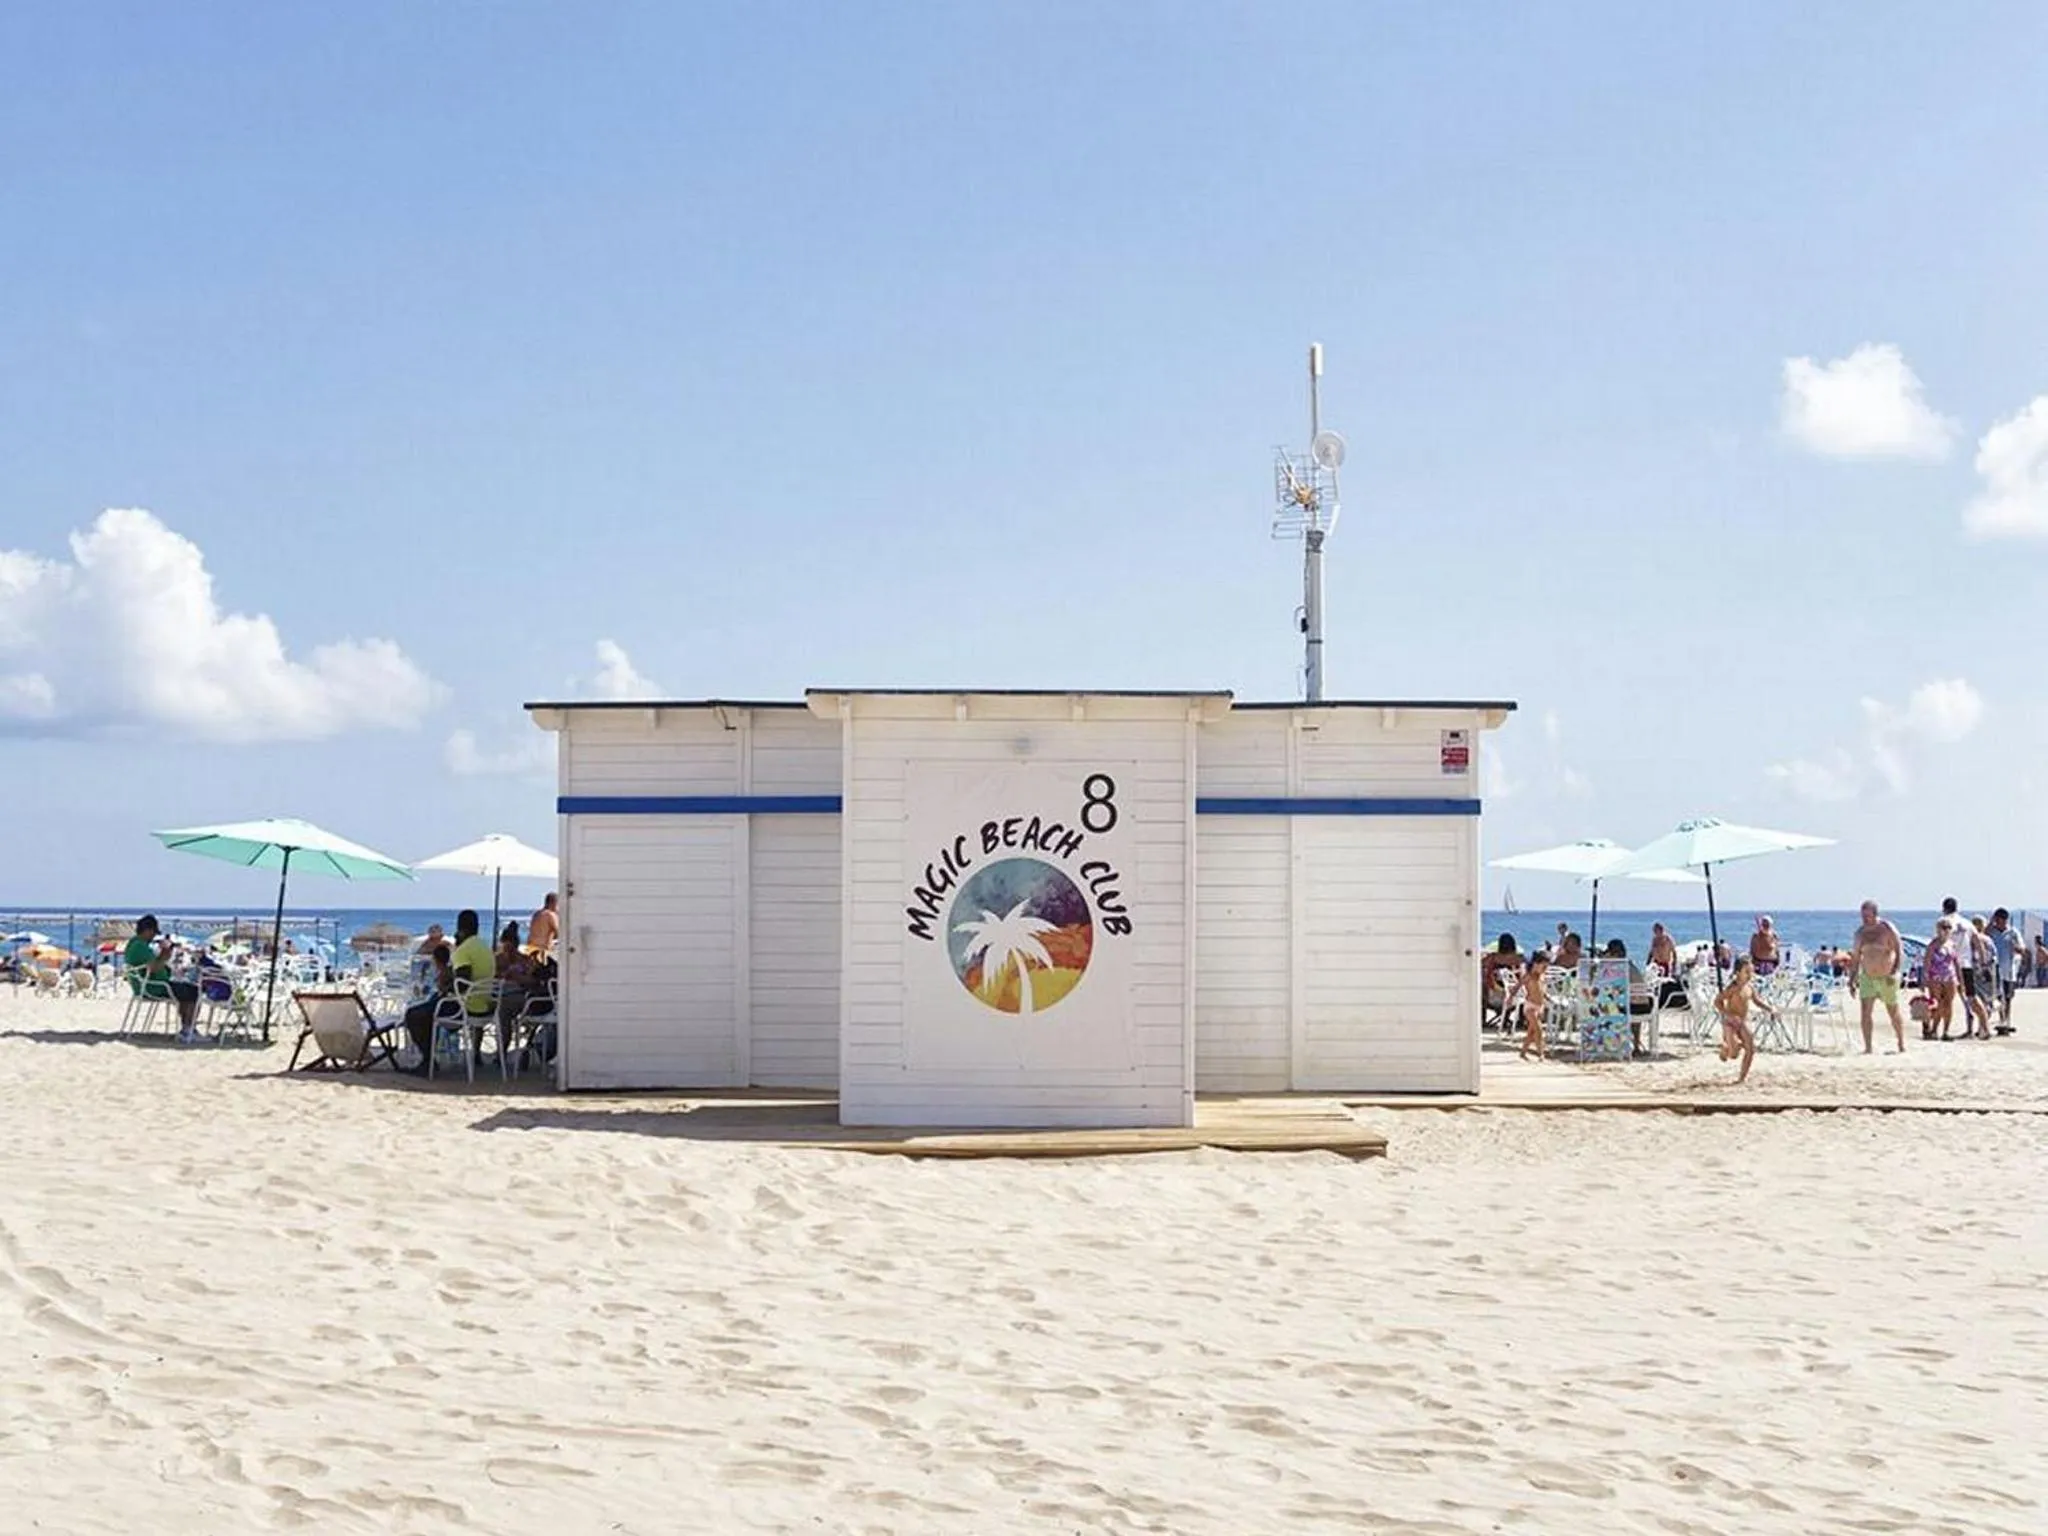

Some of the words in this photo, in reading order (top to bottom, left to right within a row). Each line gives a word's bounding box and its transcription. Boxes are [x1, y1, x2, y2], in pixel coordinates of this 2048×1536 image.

[1081, 774, 1117, 833] 8
[906, 835, 971, 940] MAGIC
[980, 816, 1084, 858] BEACH
[1080, 861, 1132, 936] CLUB
